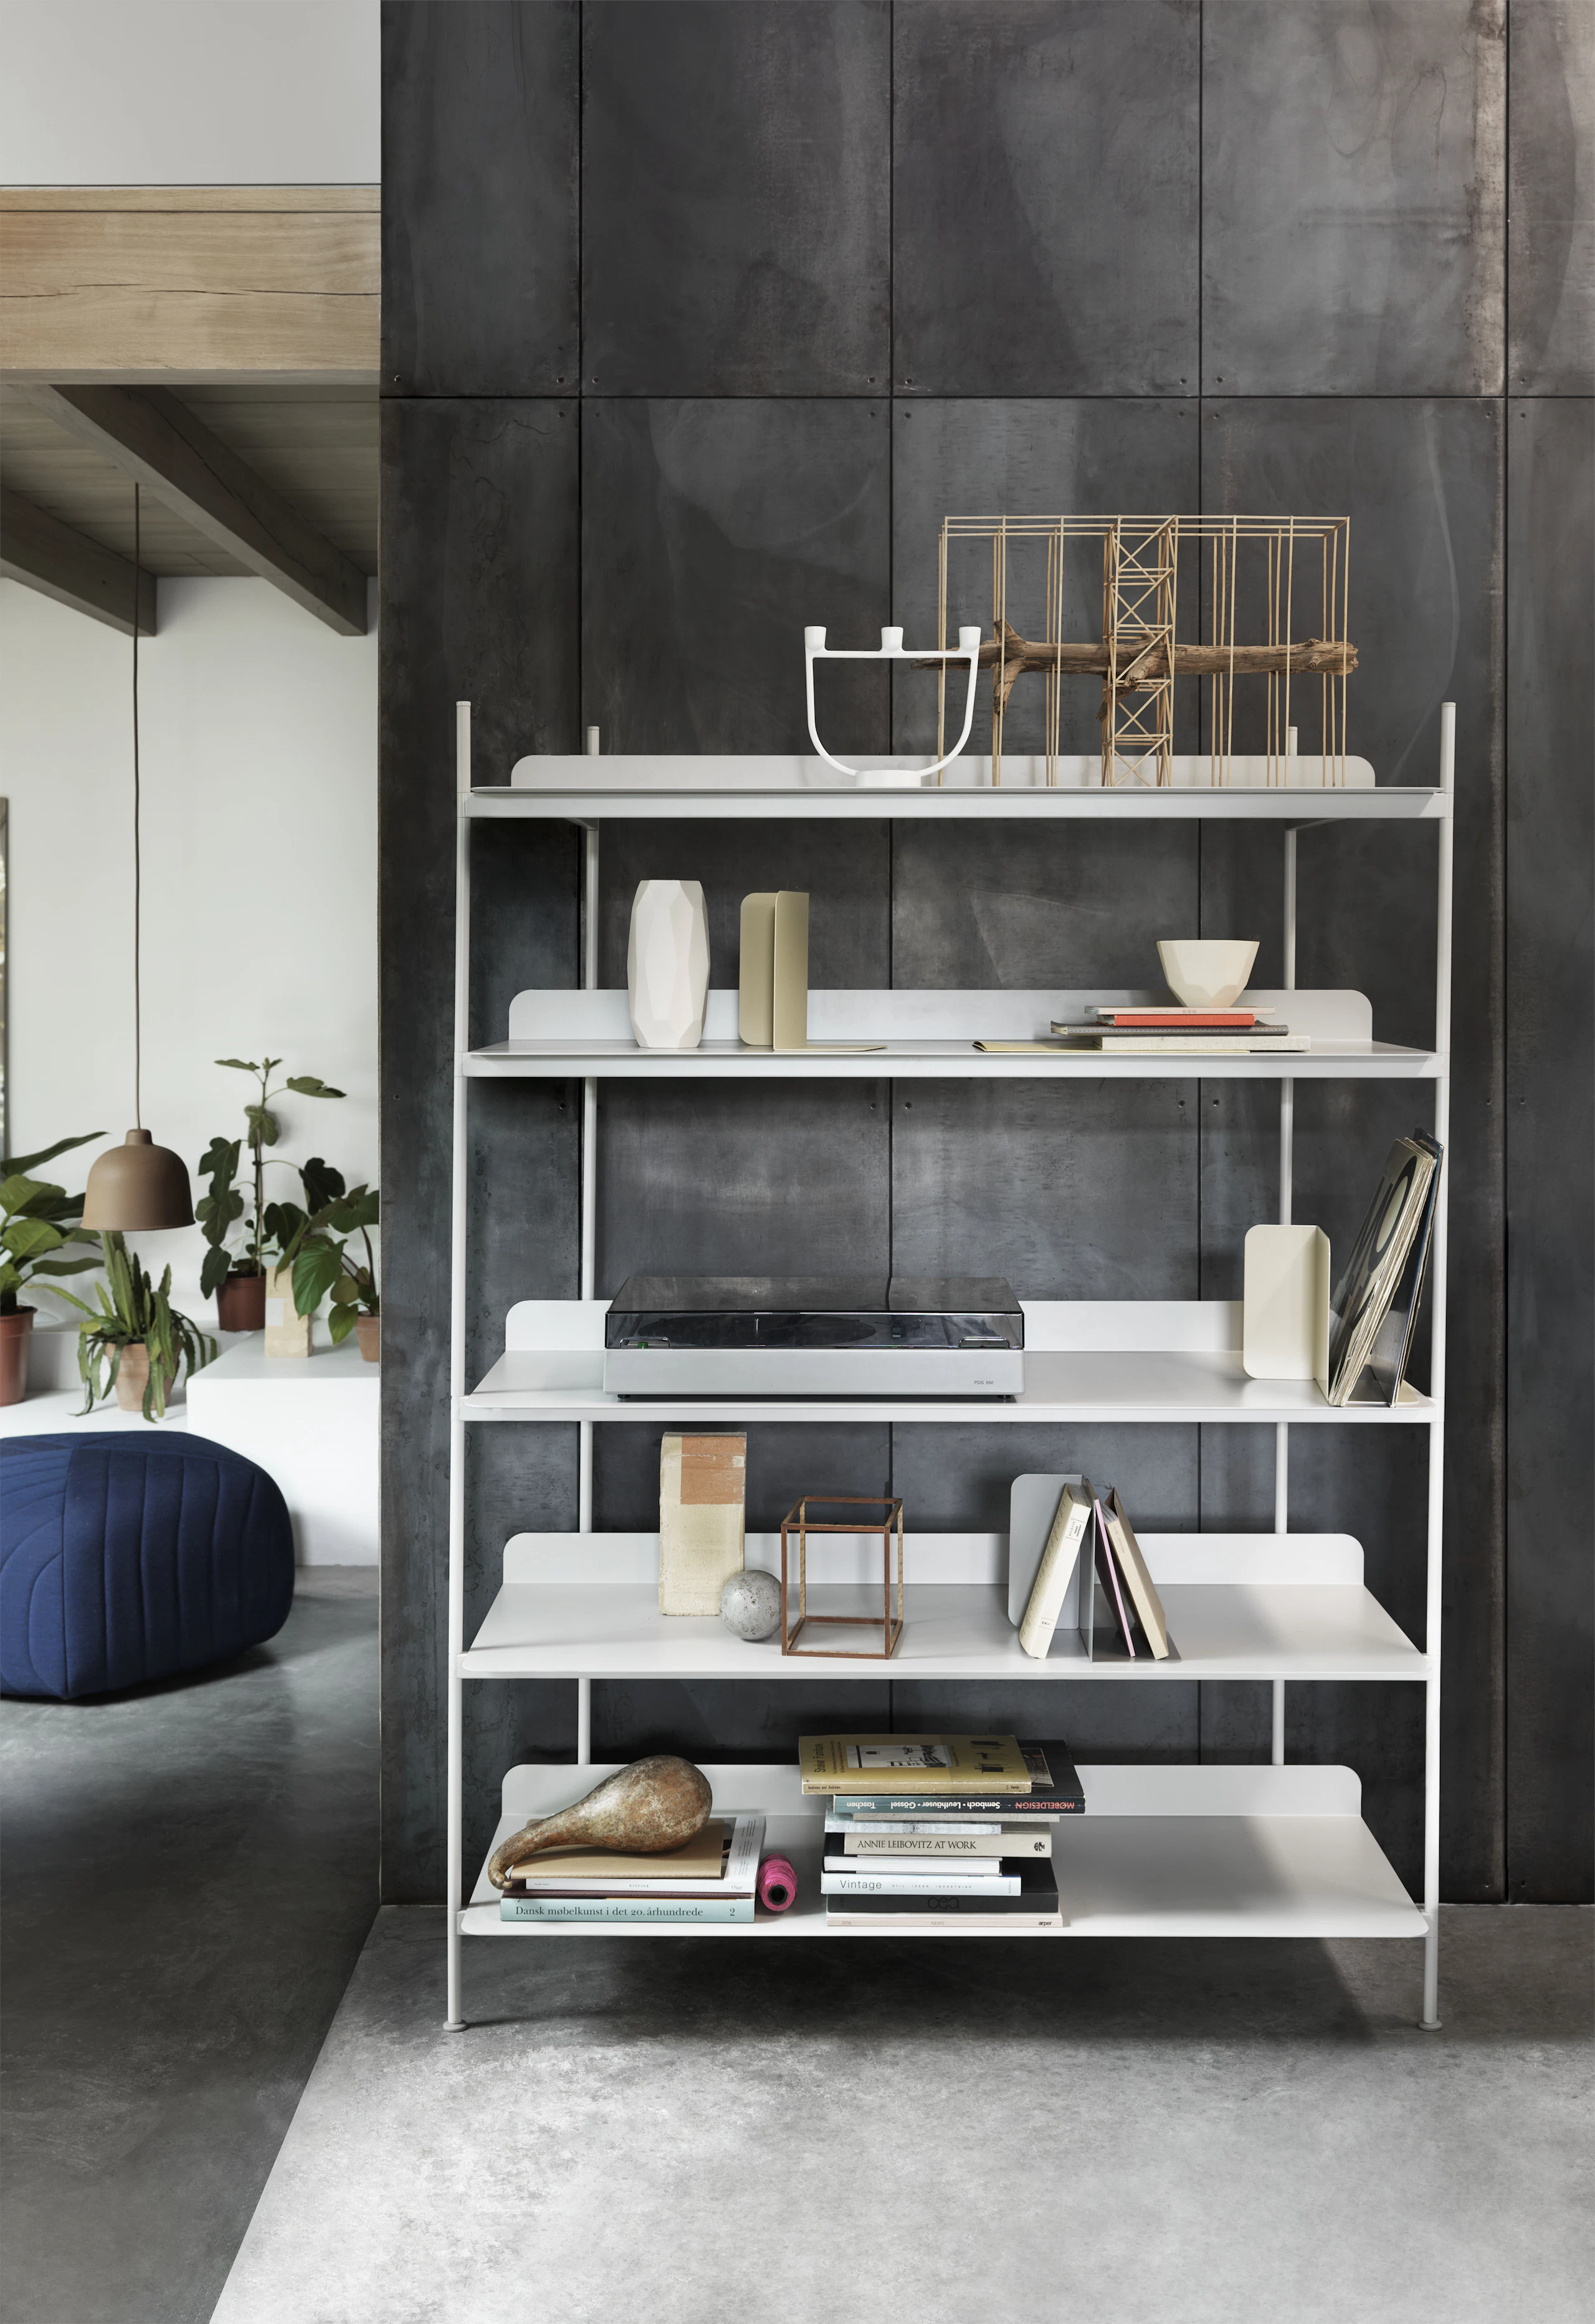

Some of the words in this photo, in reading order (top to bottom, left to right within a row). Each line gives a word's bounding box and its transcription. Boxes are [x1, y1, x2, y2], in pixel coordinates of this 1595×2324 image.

[857, 1840, 885, 1848] ANNIE
[888, 1841, 933, 1849] LEIBOVITZ
[934, 1841, 946, 1849] AT
[948, 1841, 977, 1849] WORK
[840, 1880, 882, 1891] Vintage
[516, 1906, 545, 1915] Dansk
[548, 1907, 604, 1916] møbelkunst
[606, 1907, 609, 1915] i
[612, 1907, 628, 1916] det
[647, 1907, 703, 1916] århundrede
[730, 1908, 735, 1917] 2
